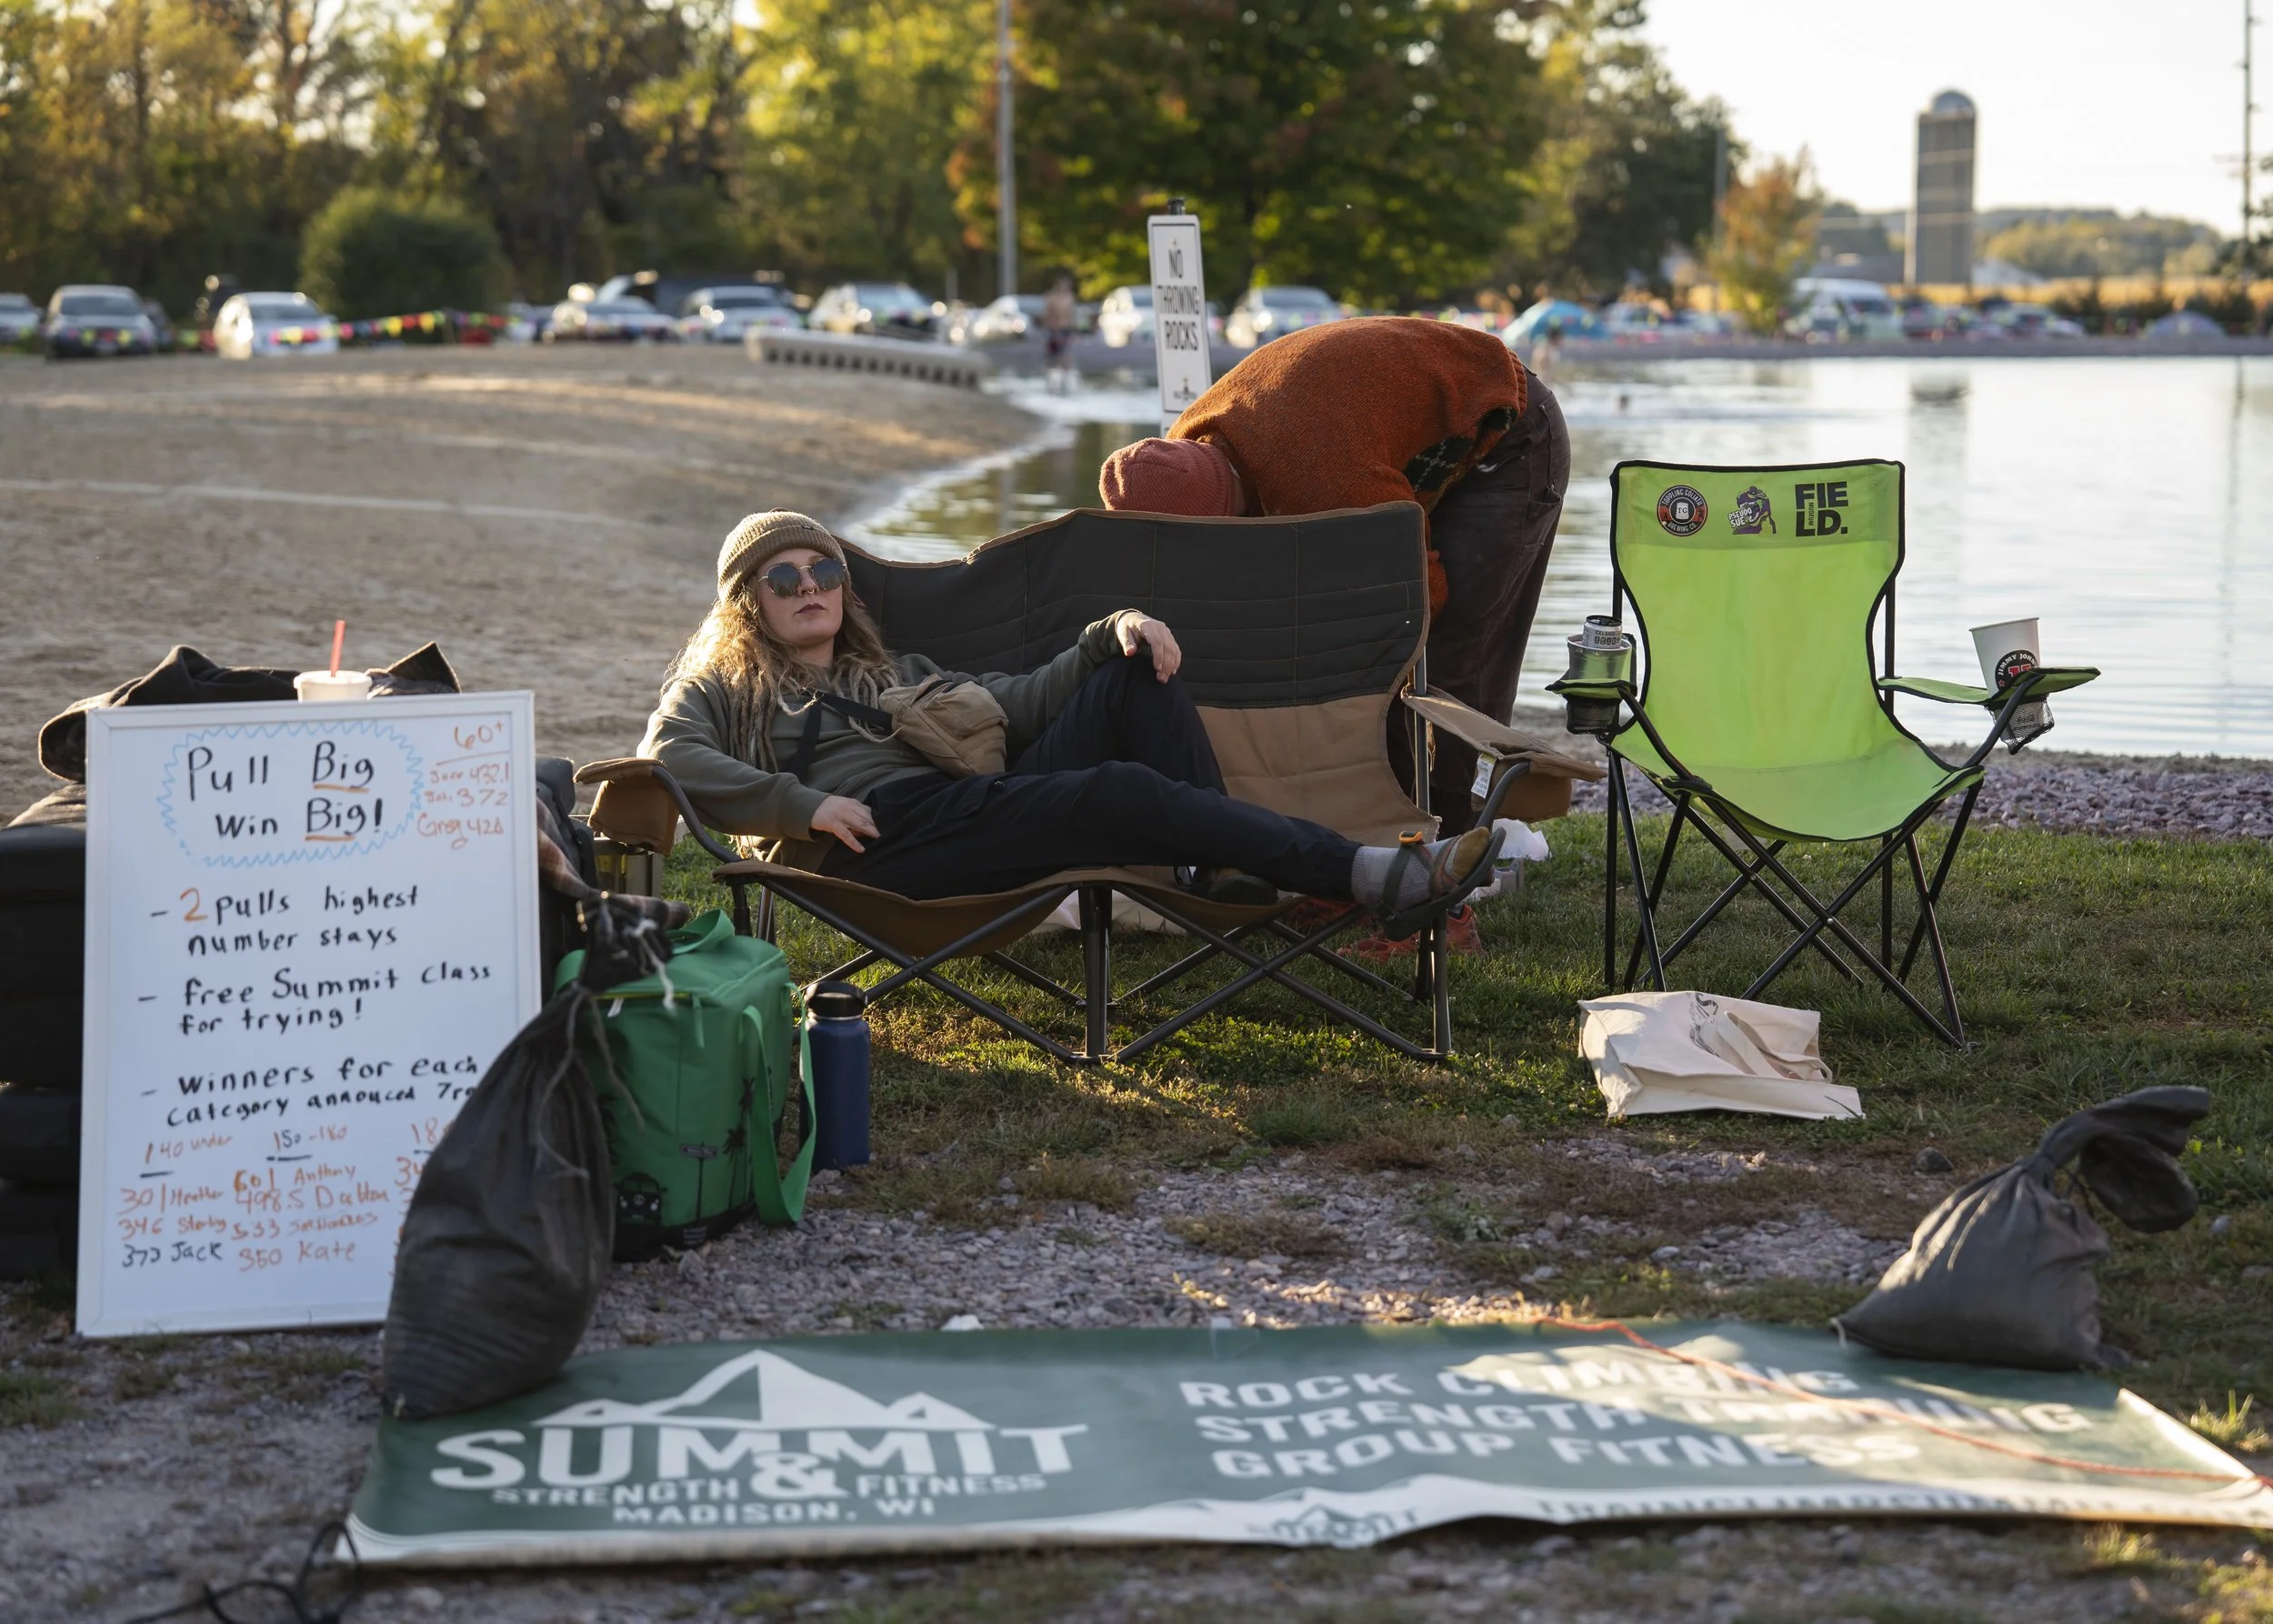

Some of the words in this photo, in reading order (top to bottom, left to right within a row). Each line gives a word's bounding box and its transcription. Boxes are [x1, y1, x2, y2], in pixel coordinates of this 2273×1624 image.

[1168, 249, 1184, 278] NO
[1157, 286, 1199, 315] THROWING
[1165, 321, 1199, 351] ROCKS
[1661, 488, 1684, 506] TOPPLING
[1728, 506, 1753, 520] PSEUDO
[1730, 516, 1746, 528] SUE
[1998, 655, 2017, 676] JIMMY
[188, 746, 269, 801] Pull
[312, 741, 375, 788] Big
[306, 797, 383, 837] Big!
[180, 887, 209, 922] 2
[215, 887, 291, 926] pulls
[324, 884, 419, 914] highest
[187, 930, 299, 957] number
[319, 925, 398, 957] stays
[272, 967, 400, 1001] Summit
[179, 1009, 223, 1036] for
[242, 999, 362, 1034] trying!
[338, 1056, 393, 1080] for
[411, 1055, 478, 1078] each
[307, 1086, 416, 1108] annouced
[171, 1240, 223, 1262] Jack
[298, 1239, 356, 1263] Kate
[1179, 1372, 1415, 1408] ROCK
[1438, 1360, 1859, 1398] CLIMBING
[1195, 1398, 1647, 1442] STRENGTH
[430, 1423, 1089, 1490] SUMMIT
[1211, 1429, 1515, 1478] GROUP
[1547, 1433, 1921, 1467] FITNESS
[491, 1478, 739, 1508] STRENGTH
[749, 1451, 849, 1500] &
[856, 1472, 1048, 1499] FITNESS
[876, 1497, 935, 1517] WI
